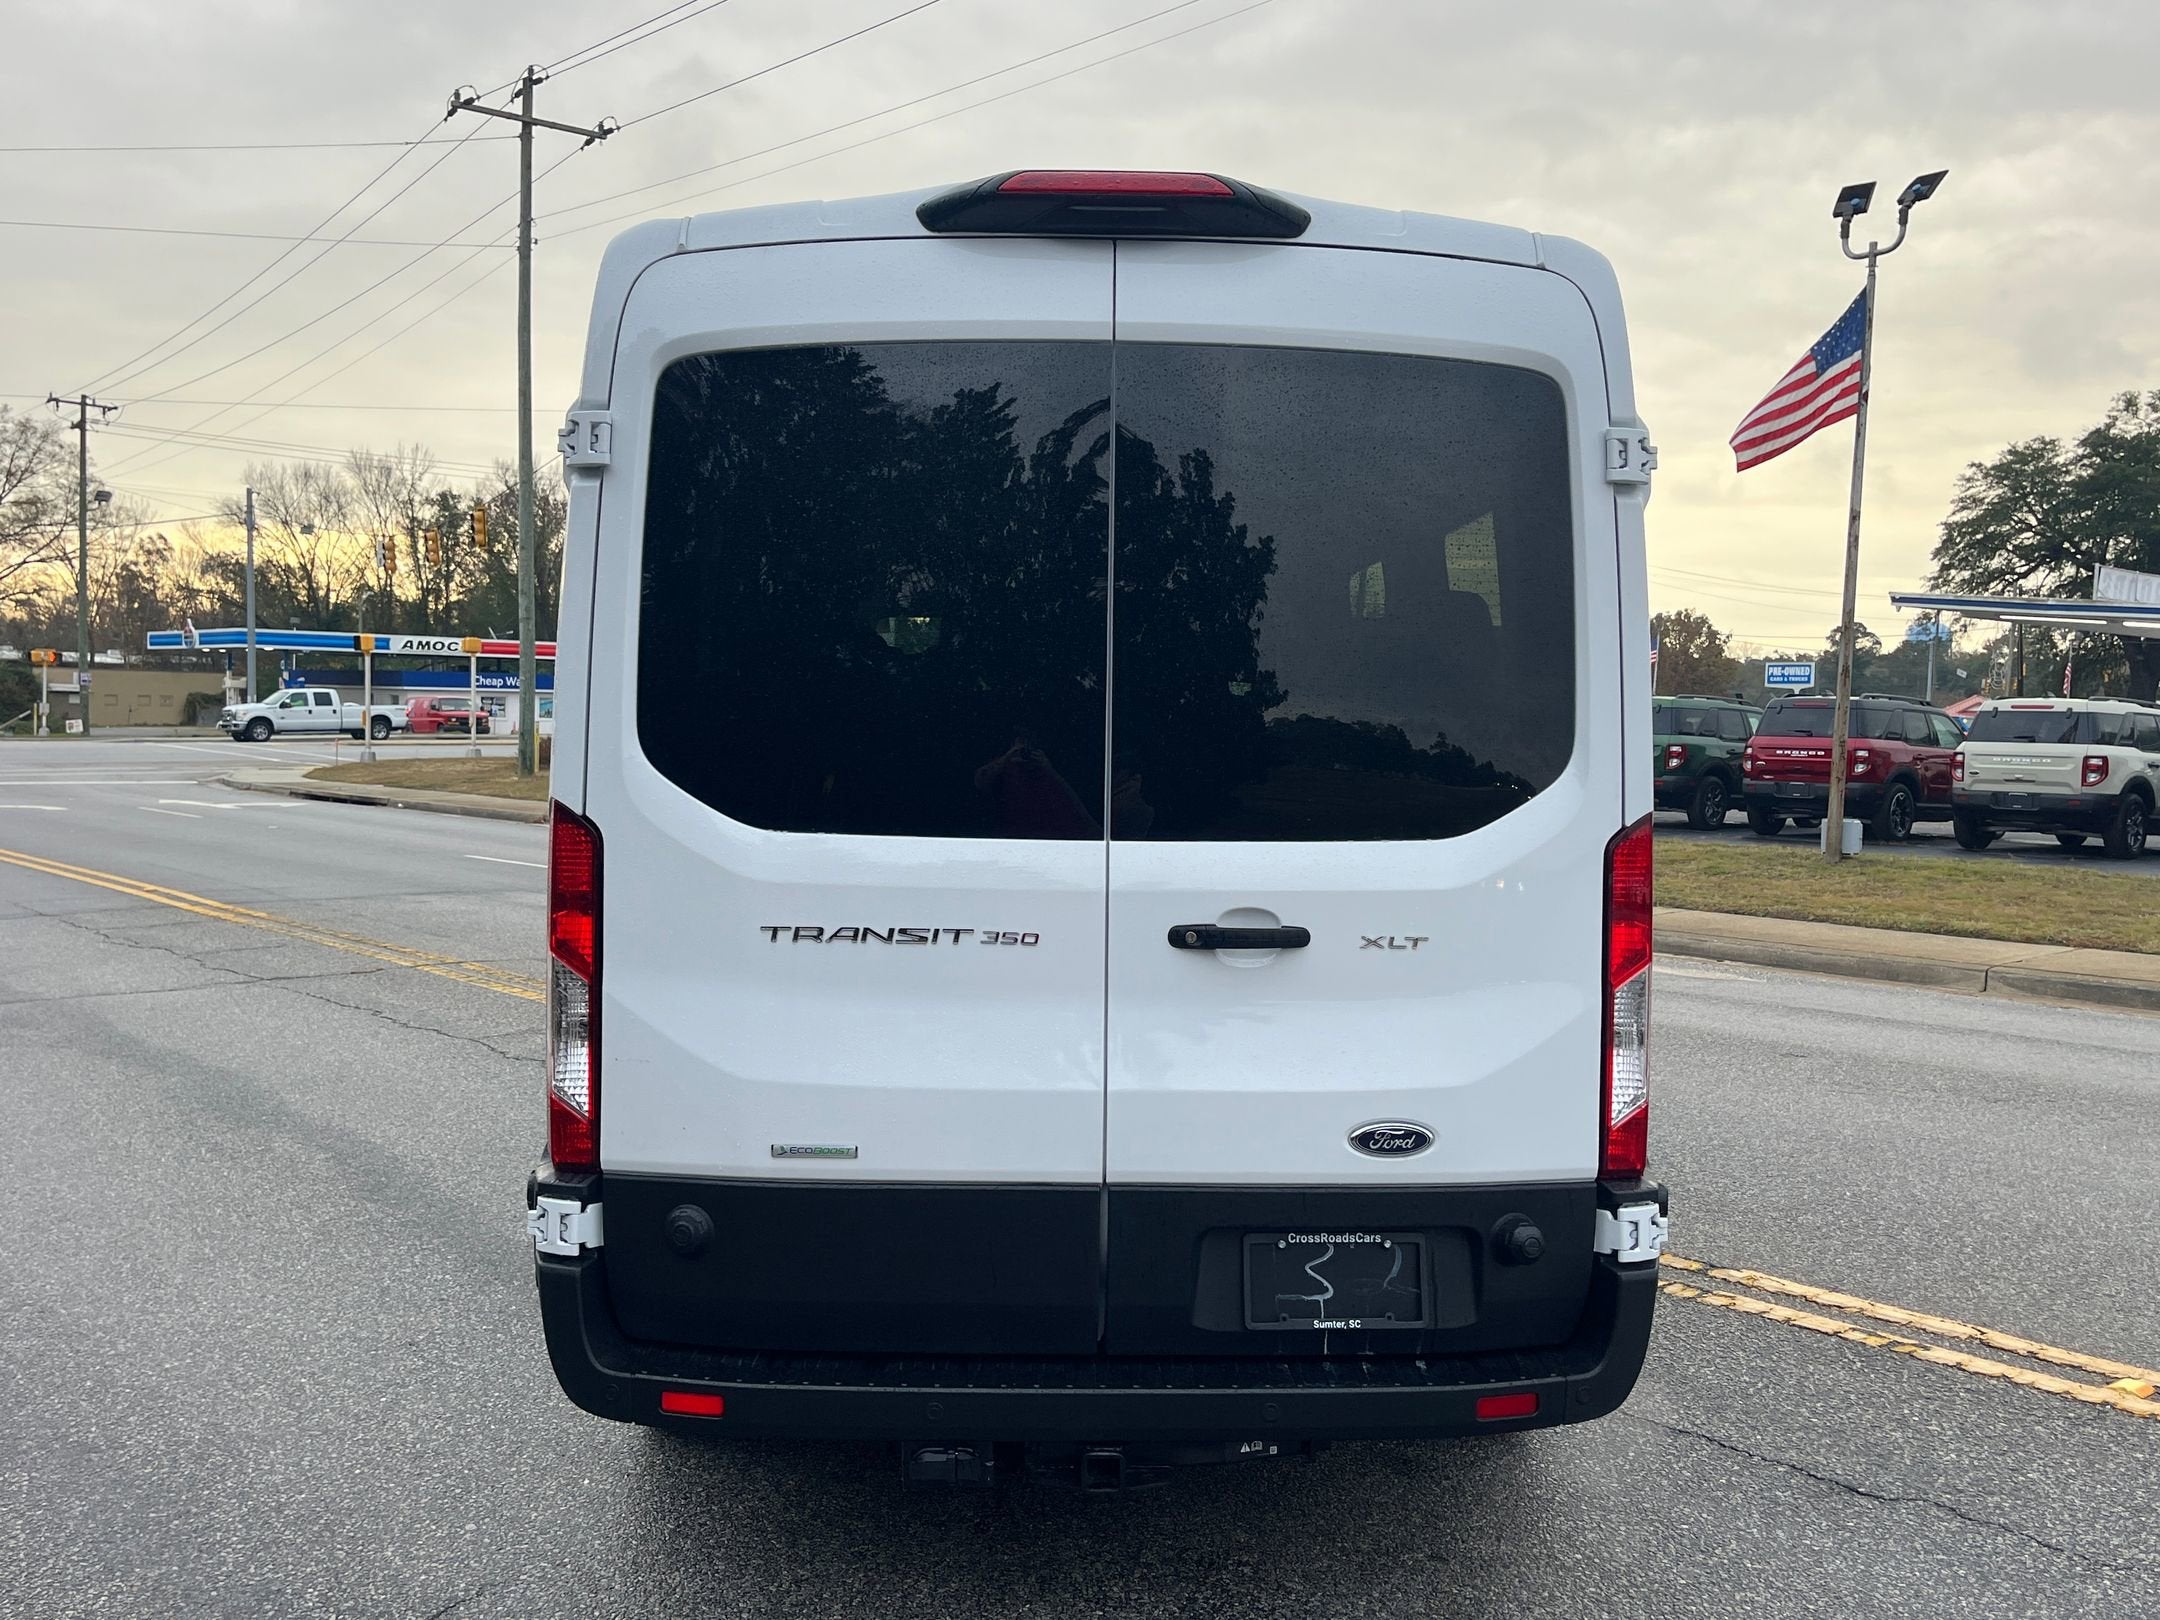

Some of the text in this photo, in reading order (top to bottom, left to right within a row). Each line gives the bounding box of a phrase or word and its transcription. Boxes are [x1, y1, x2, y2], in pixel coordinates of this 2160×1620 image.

[401, 640, 460, 652] AMOC
[1768, 666, 1810, 676] PRE-OWNED
[475, 674, 521, 689] Cheap Wa
[760, 925, 1040, 947] TRANSIT 350
[1359, 935, 1430, 951] XLT
[1369, 1130, 1415, 1151] Ford
[1287, 1233, 1382, 1244] CrossRoadsCars
[1313, 1319, 1362, 1330] Sumter, SC
